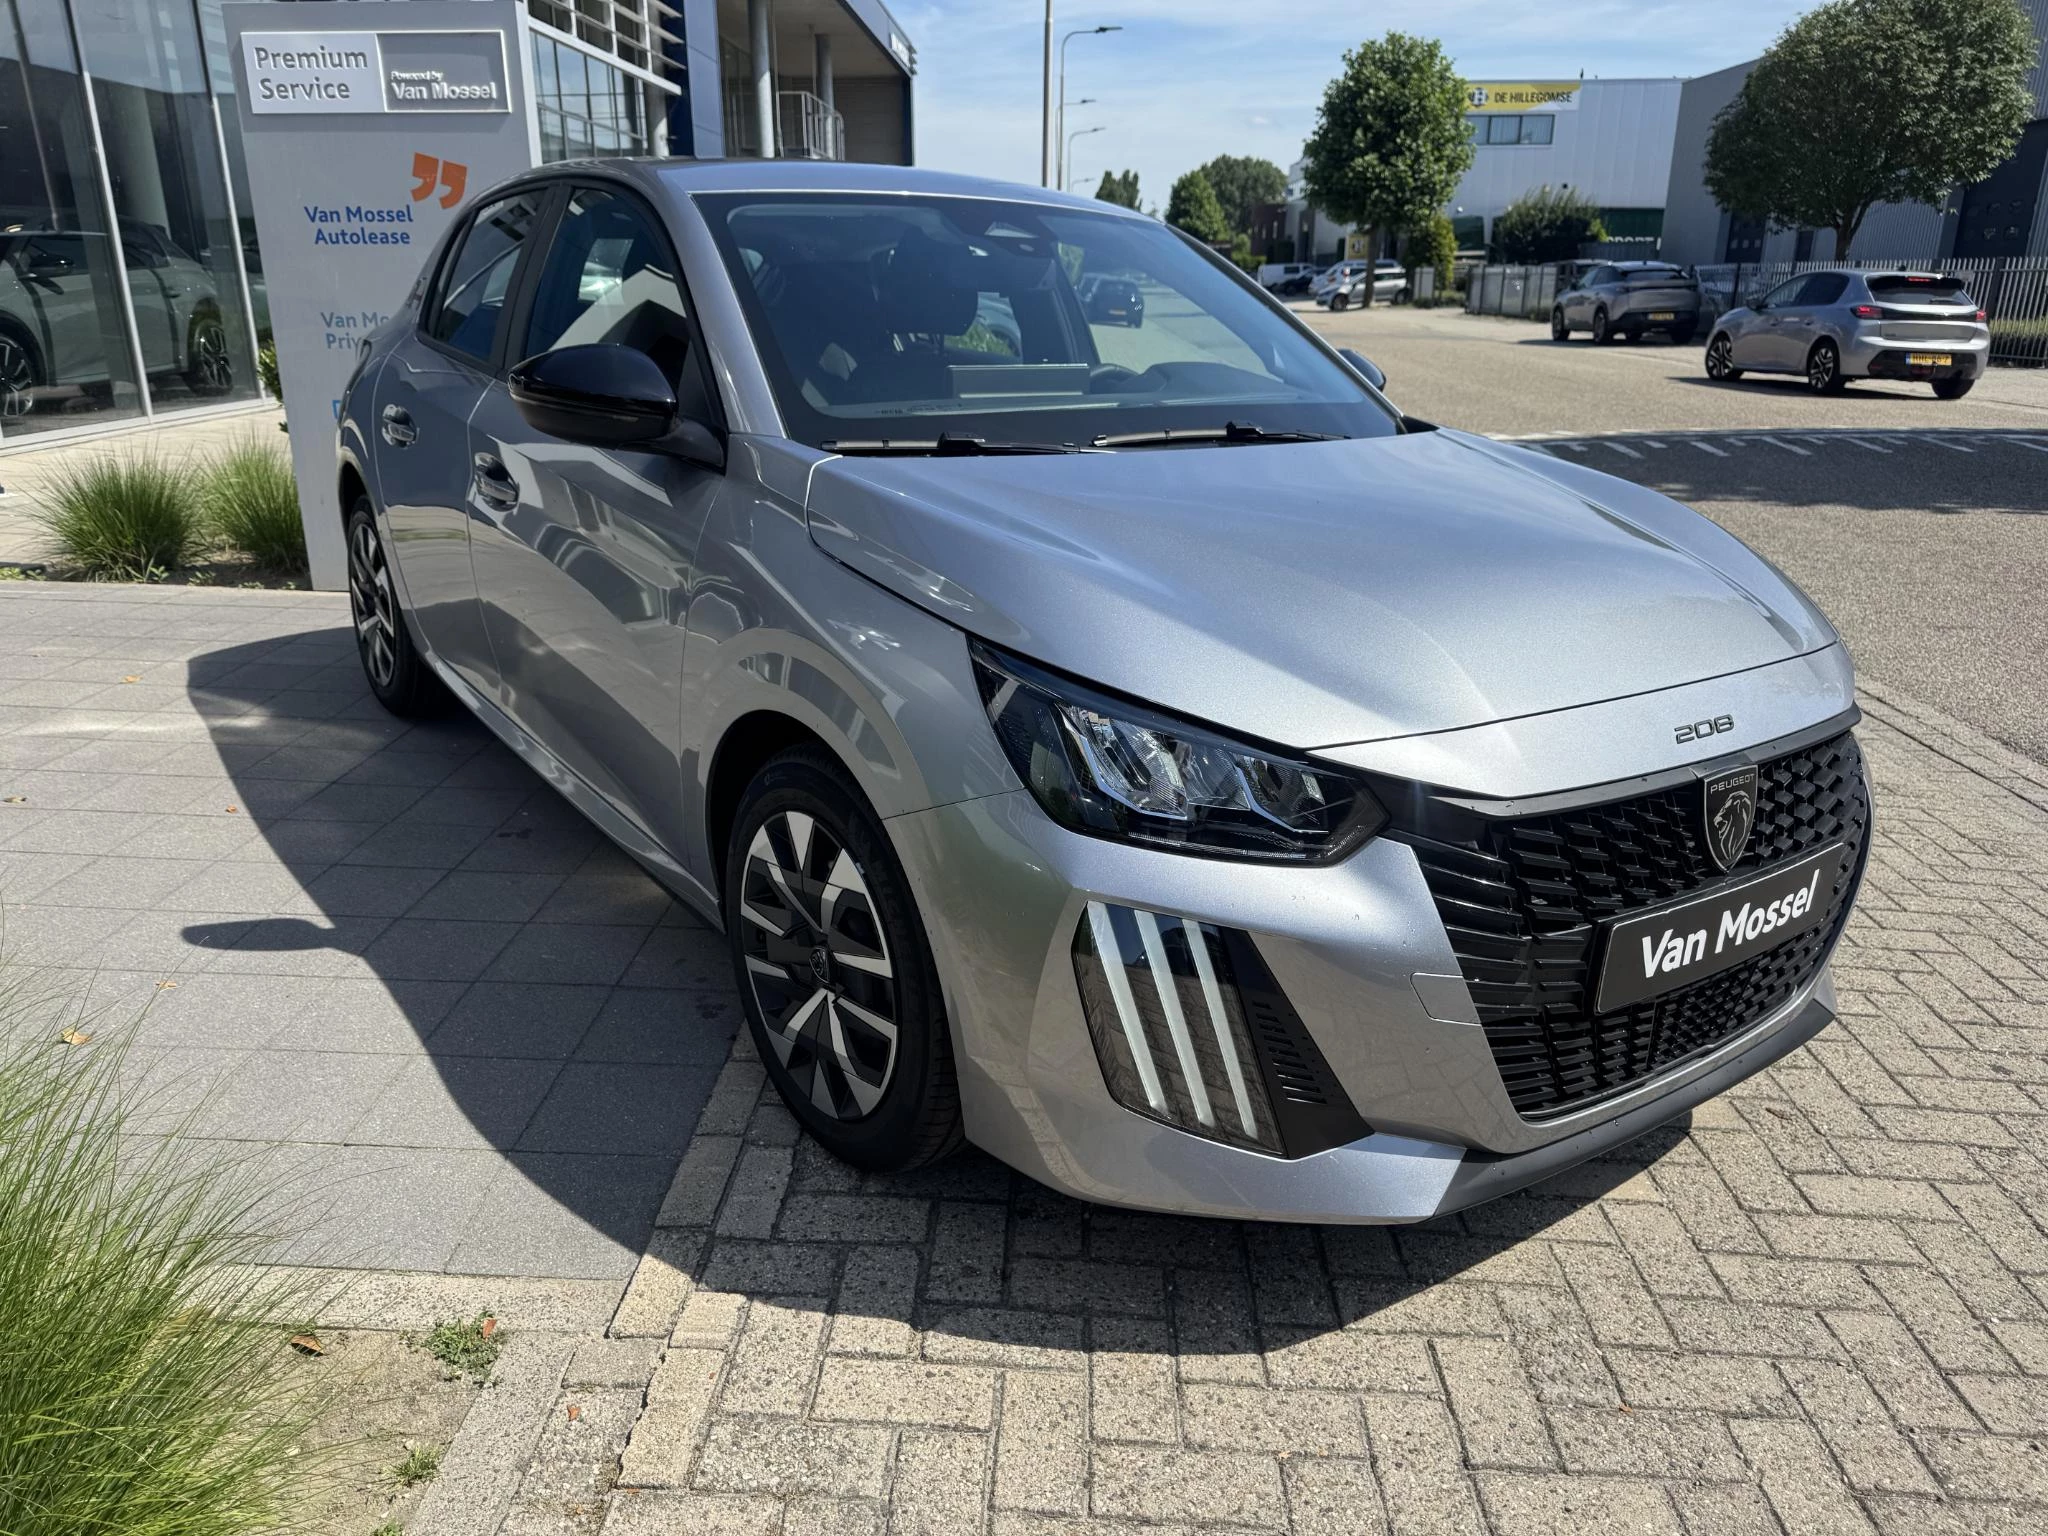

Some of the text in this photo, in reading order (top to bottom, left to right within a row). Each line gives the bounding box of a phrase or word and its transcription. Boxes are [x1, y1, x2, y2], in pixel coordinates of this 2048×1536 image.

[254, 46, 368, 70] Premium
[391, 71, 444, 82] Powered by
[261, 77, 351, 101] Service
[391, 81, 497, 99] Van Mossel
[1494, 92, 1508, 103] DE
[304, 205, 414, 223] Van Mossel
[314, 228, 411, 245] Autolease
[320, 312, 358, 328] Van
[1674, 714, 1735, 744] 208
[1710, 773, 1755, 795] PEUGEOT
[1641, 868, 1820, 979] Van Mossel
